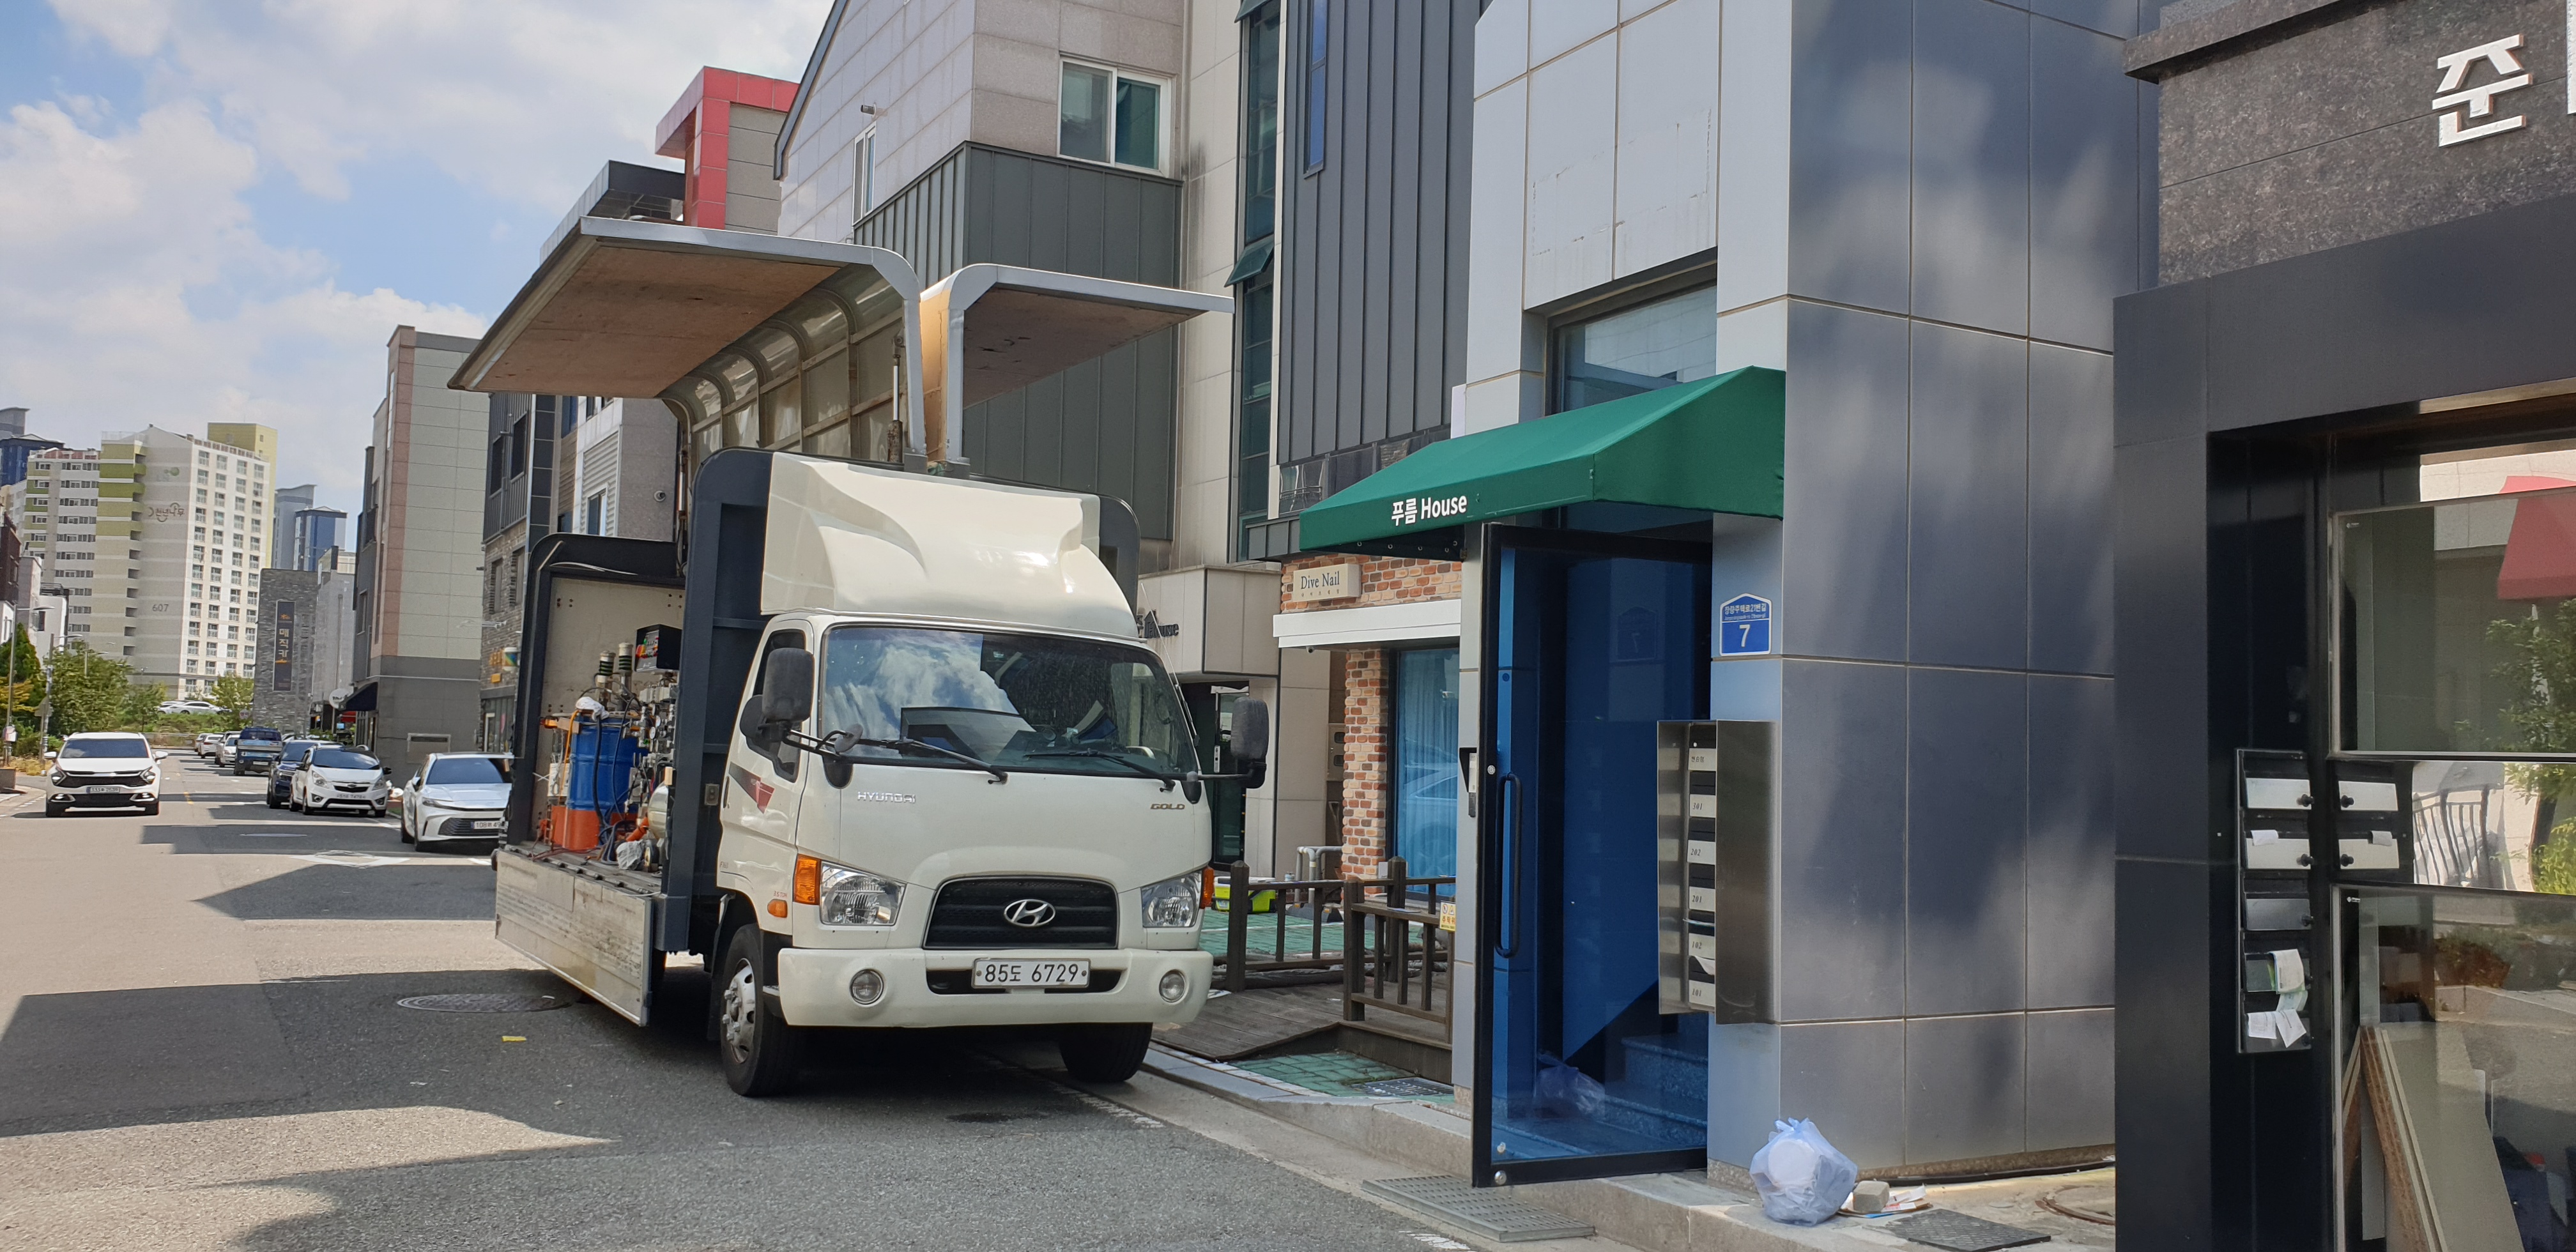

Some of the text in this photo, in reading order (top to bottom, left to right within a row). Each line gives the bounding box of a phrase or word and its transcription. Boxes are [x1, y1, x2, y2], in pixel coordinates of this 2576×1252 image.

[2432, 34, 2533, 148] 준
[1392, 496, 1467, 526] 푸름 House
[1301, 570, 1340, 590] Dive Nail
[152, 604, 169, 612] 607
[1739, 624, 1751, 647] 7
[857, 791, 916, 804] HYUNDAI
[1692, 802, 1703, 811] 301
[1690, 848, 1701, 857] 202
[1692, 895, 1702, 903] 201
[1692, 941, 1702, 949] 102
[985, 964, 1078, 982] 85도 6729
[1692, 988, 1702, 997] 101
